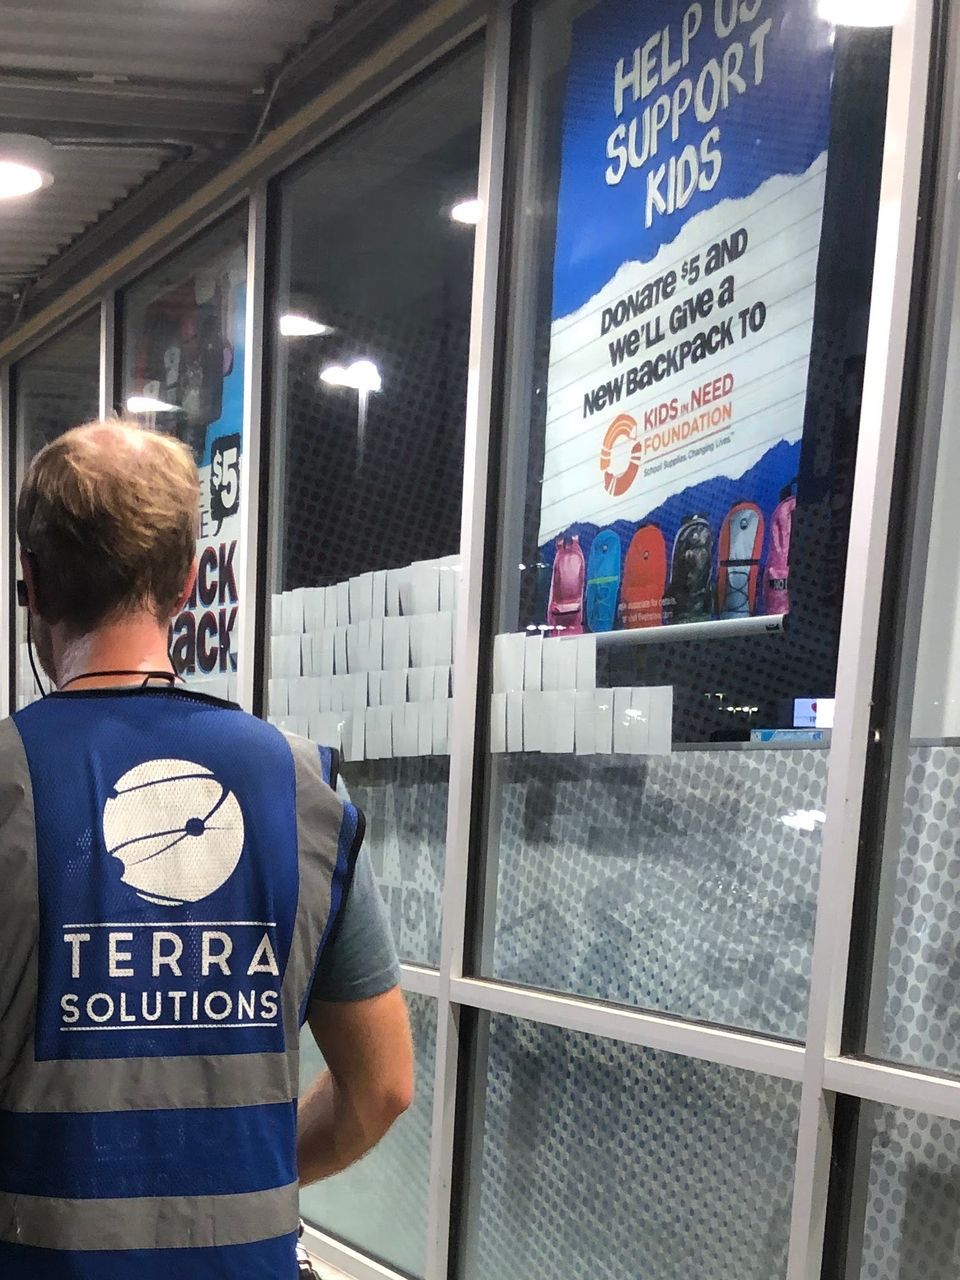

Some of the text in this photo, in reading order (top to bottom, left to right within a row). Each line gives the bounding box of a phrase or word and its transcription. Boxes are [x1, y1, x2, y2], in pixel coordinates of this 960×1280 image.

[614, 2, 702, 118] HELP
[605, 18, 772, 185] SUPPORT
[644, 126, 722, 229] KIDS
[680, 253, 700, 286] $5
[717, 274, 735, 309] a
[738, 301, 767, 339] TO
[644, 373, 734, 431] KIDS IN NEED
[644, 402, 732, 455] FOUNDATION
[212, 447, 239, 509] $5
[643, 463, 663, 477] School
[687, 442, 715, 460] Changing
[64, 931, 280, 978] TERRA
[60, 990, 279, 1023] SOLUTIONS
